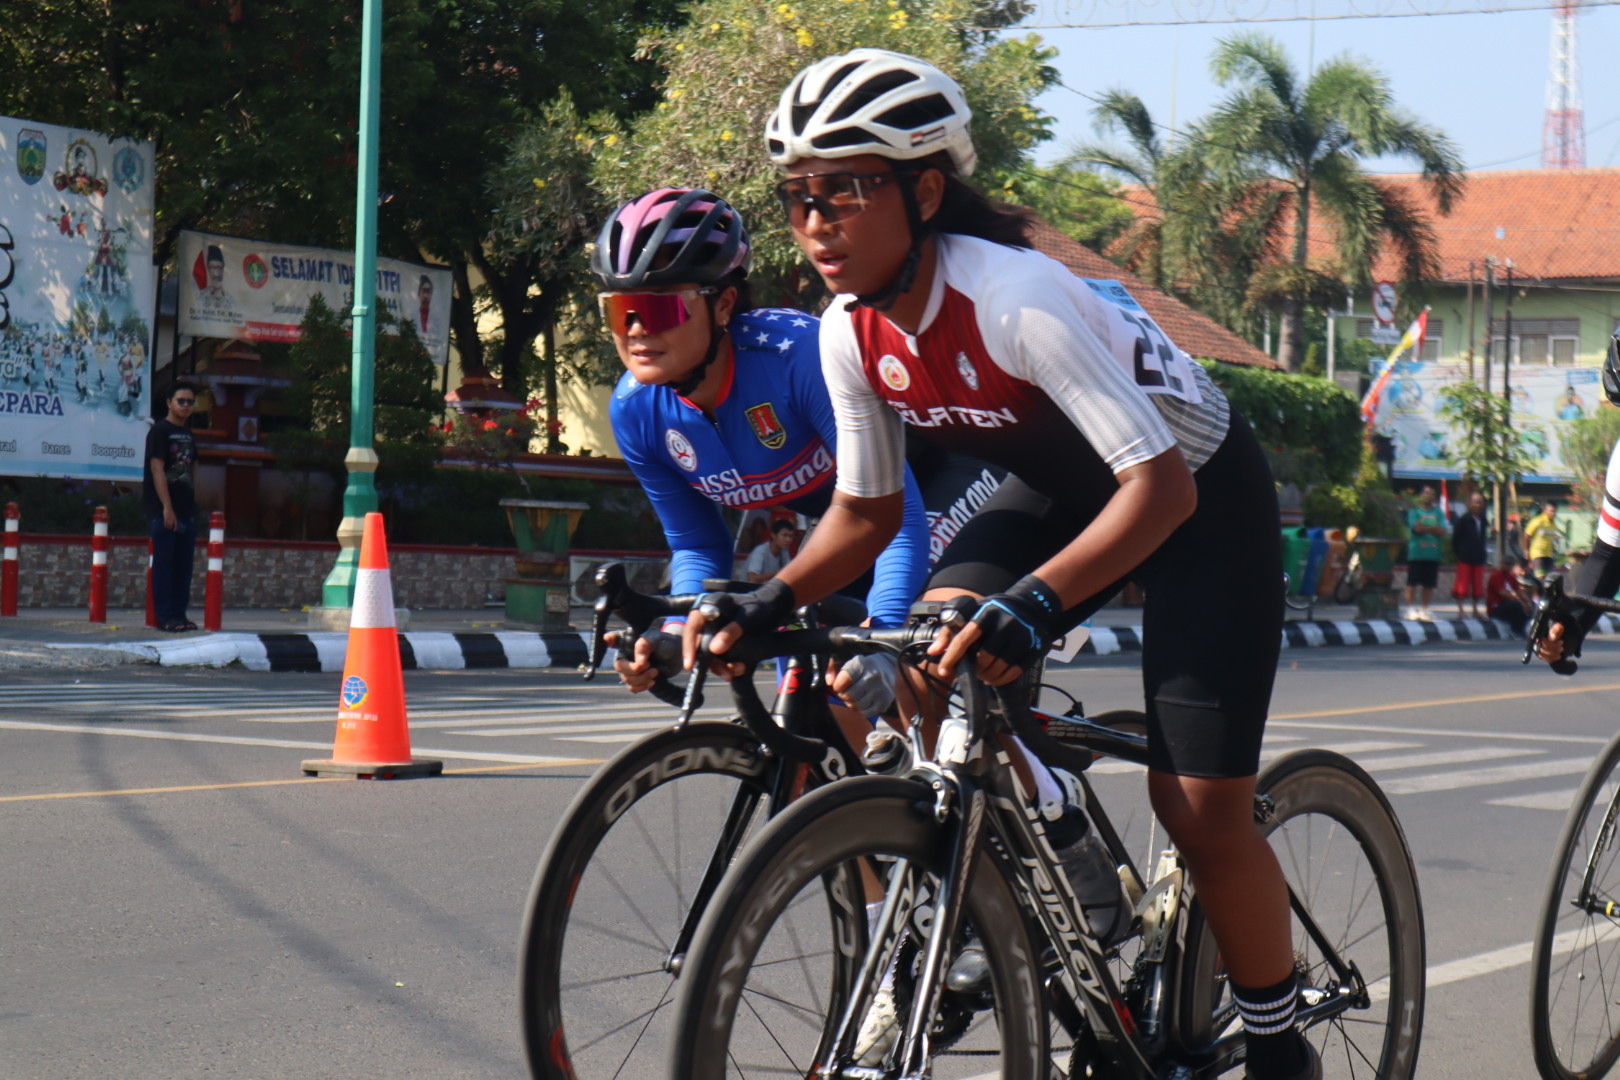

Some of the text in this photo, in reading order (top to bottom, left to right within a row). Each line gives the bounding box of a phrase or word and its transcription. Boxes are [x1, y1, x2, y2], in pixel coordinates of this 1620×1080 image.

[271, 255, 333, 283] SELAMAT
[41, 441, 72, 456] Dance
[91, 443, 136, 459] Doorprize
[698, 468, 746, 494] ISSI
[1020, 856, 1110, 1005] RIDLEY
